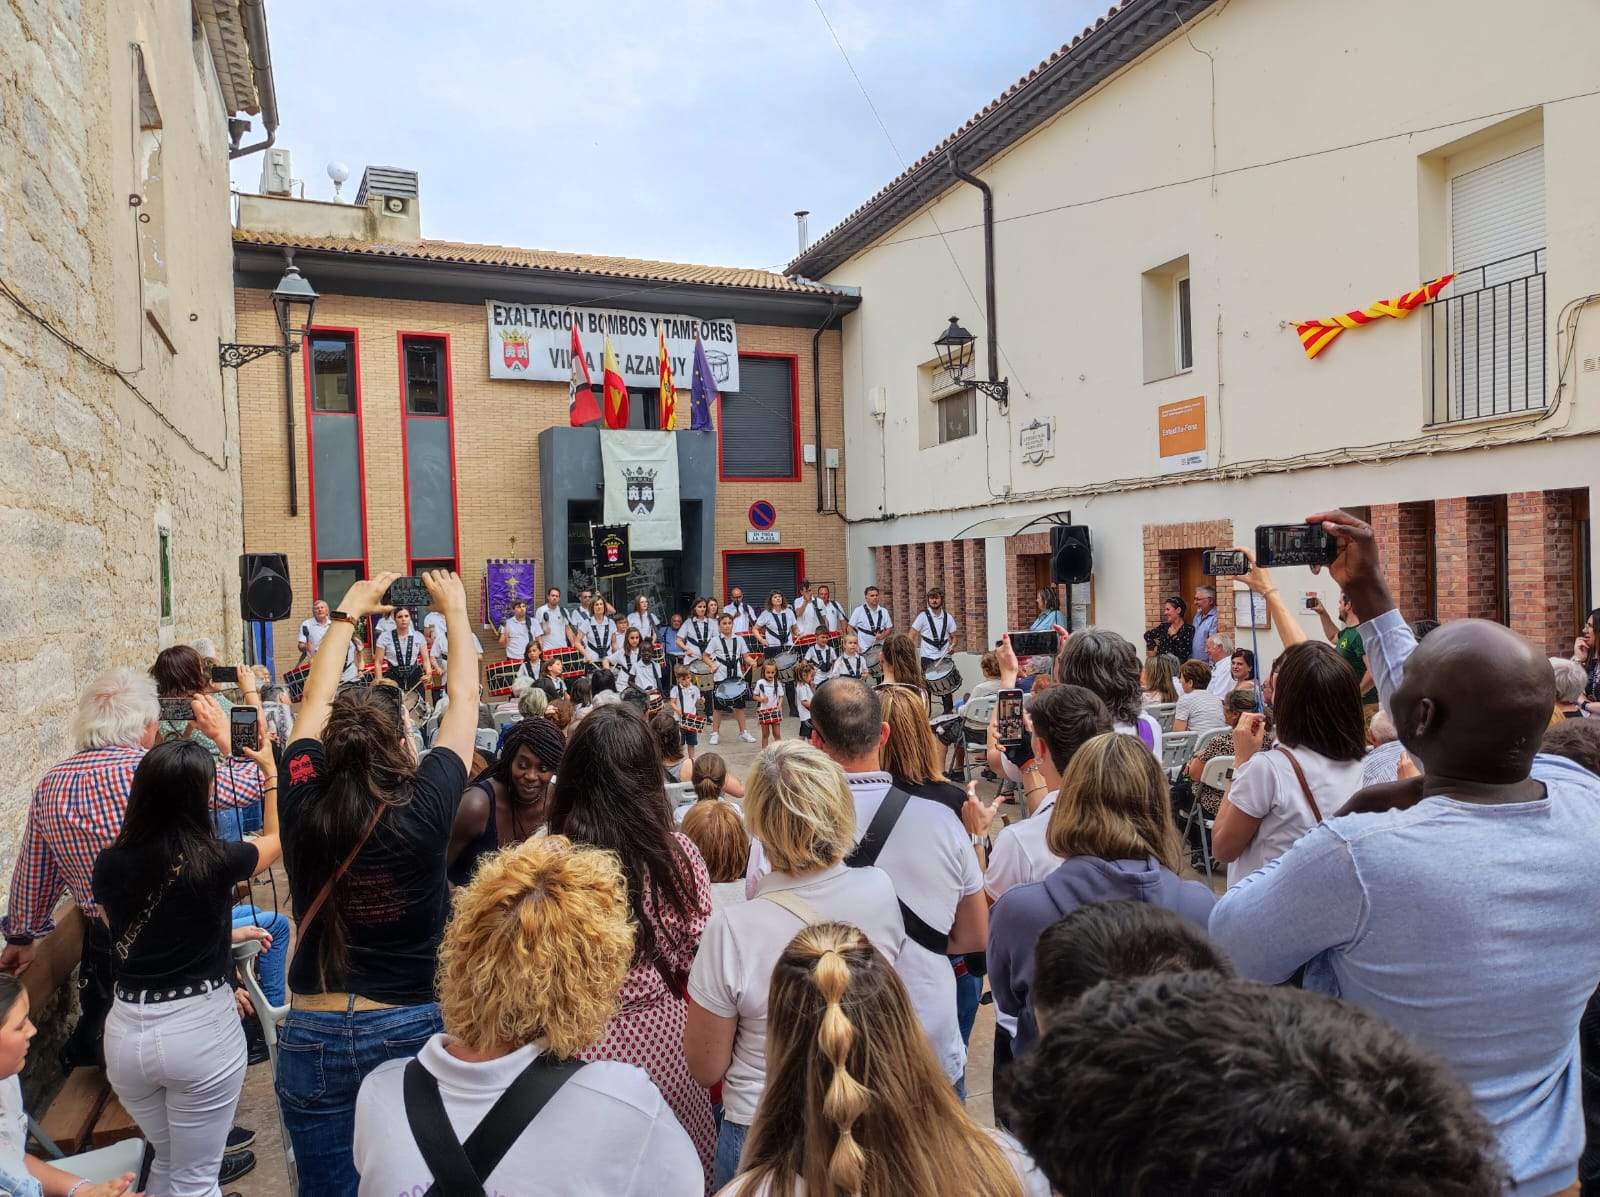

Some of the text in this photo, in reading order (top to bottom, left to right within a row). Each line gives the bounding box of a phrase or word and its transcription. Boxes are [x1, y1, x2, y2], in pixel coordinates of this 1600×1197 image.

[493, 304, 584, 332] EXALTACIÓN
[588, 312, 647, 337] BOMBOS
[650, 317, 659, 337] Y
[549, 347, 595, 372] VILA
